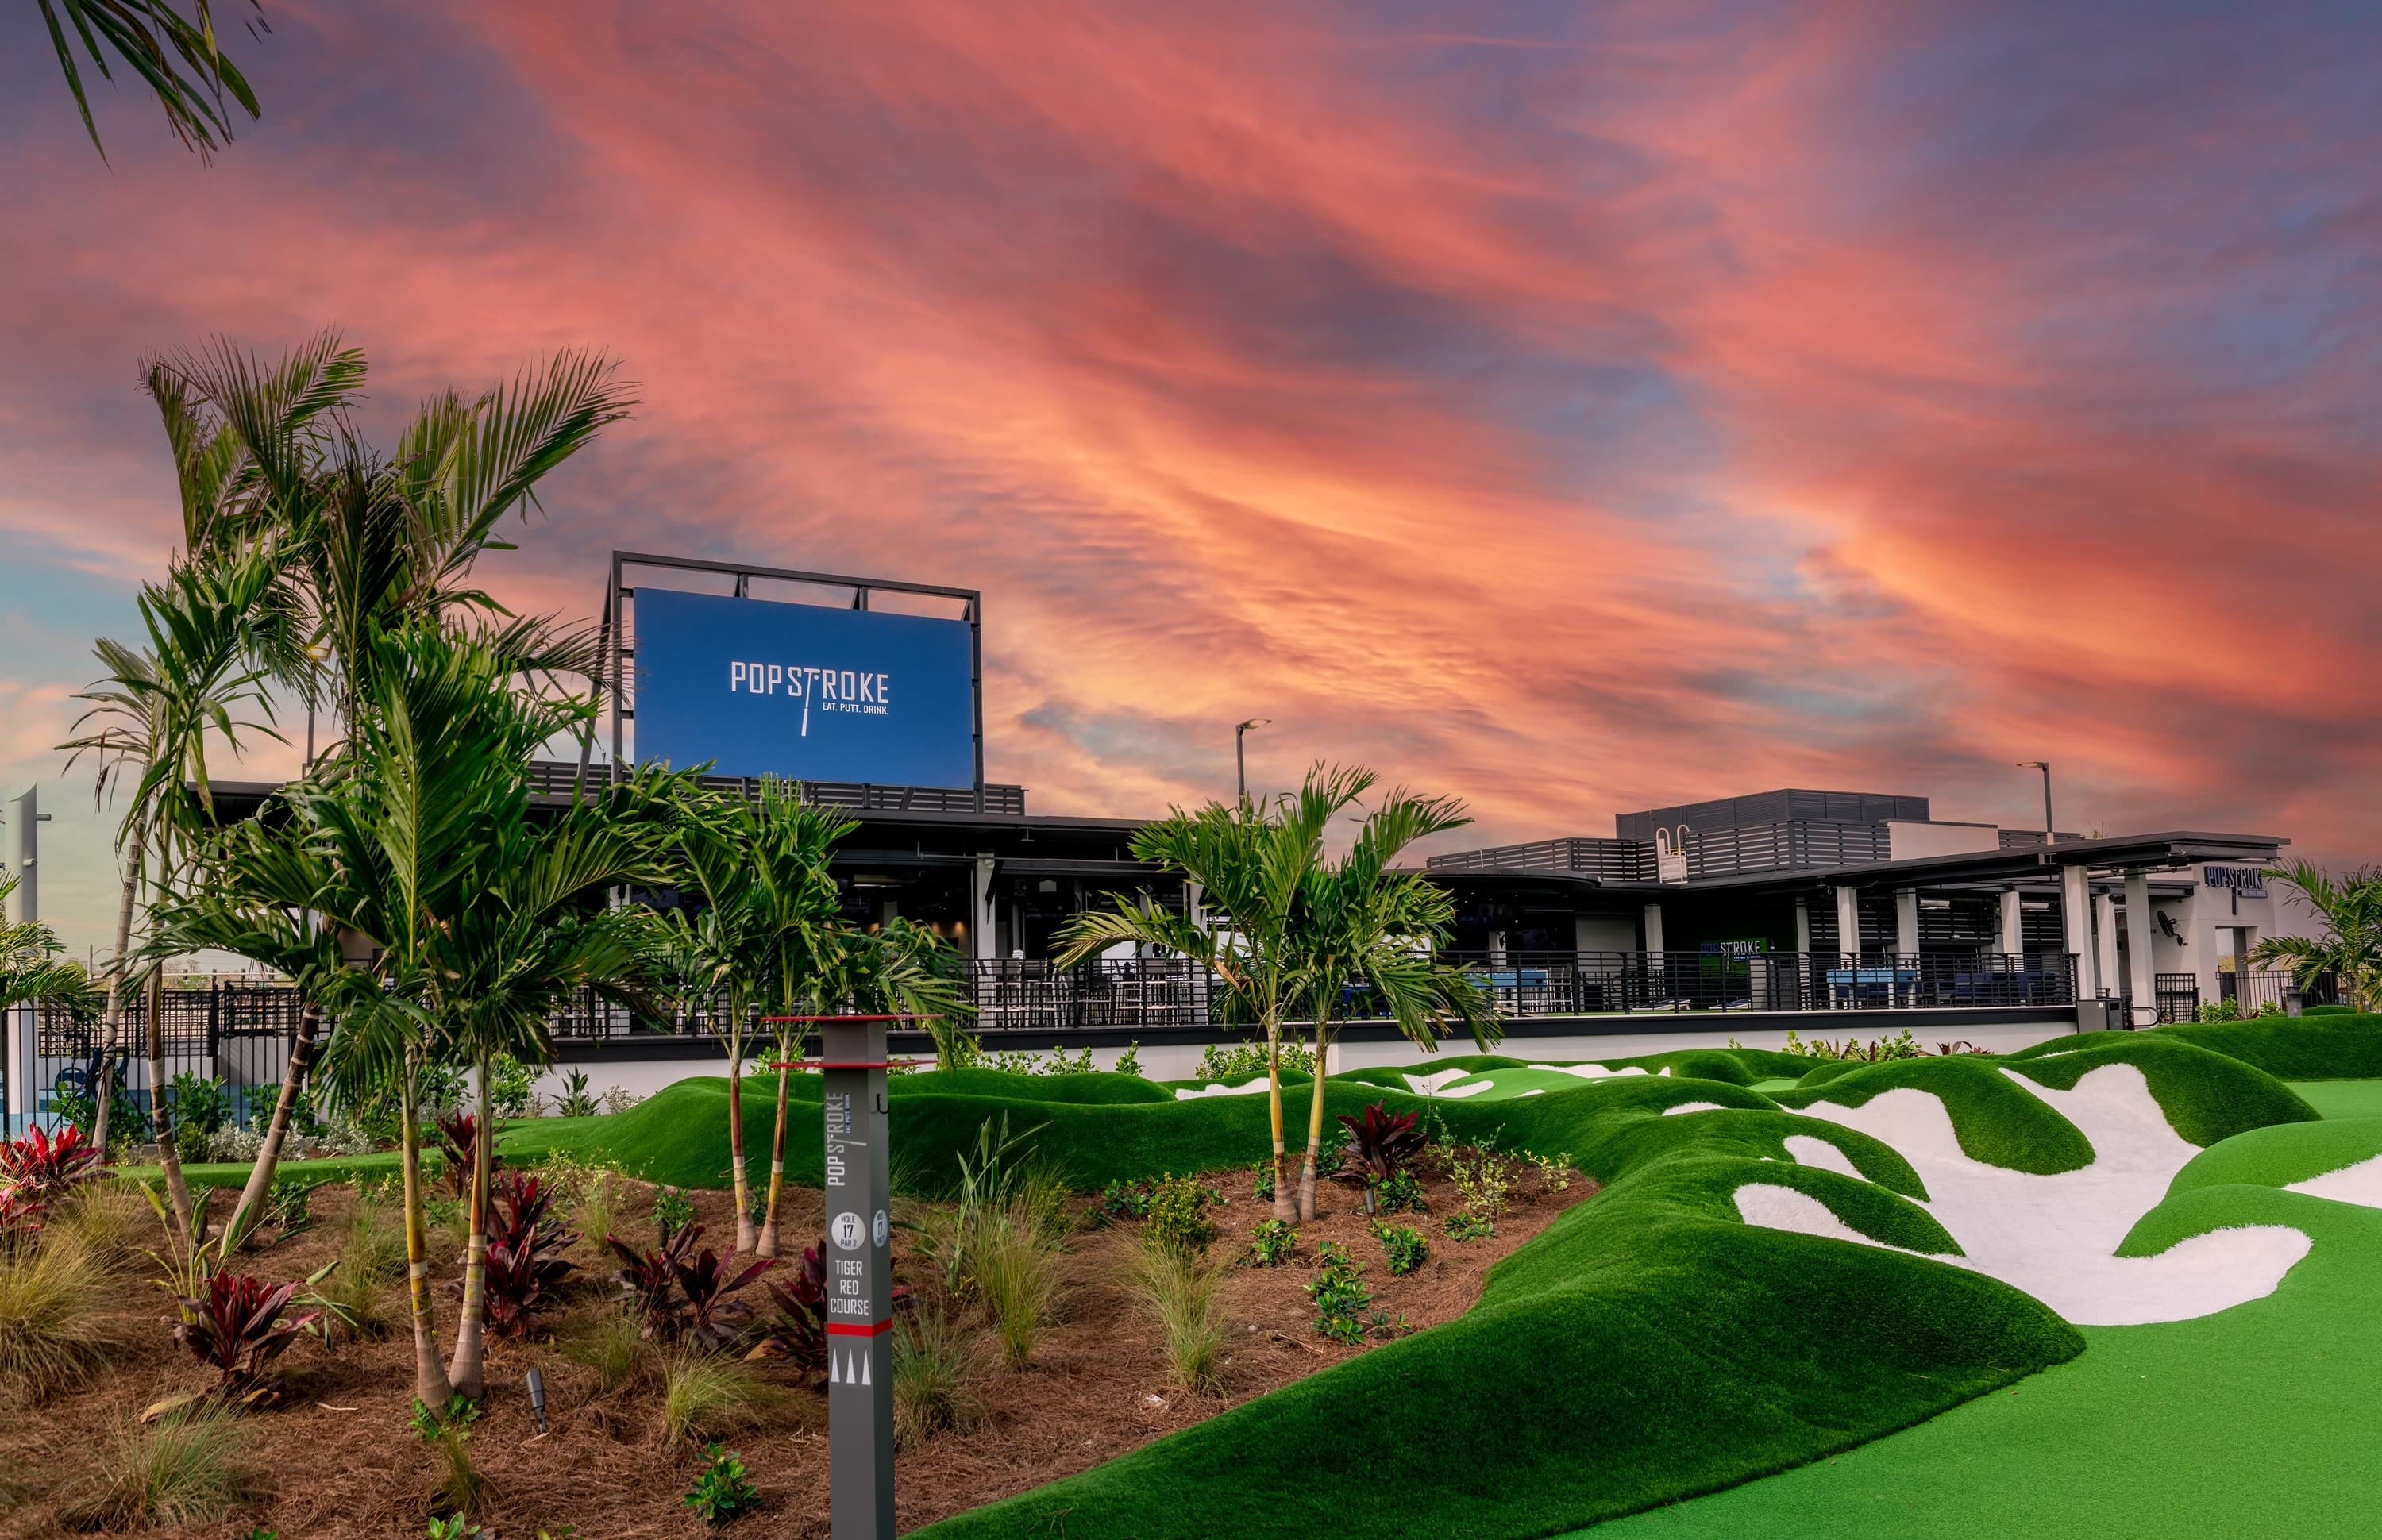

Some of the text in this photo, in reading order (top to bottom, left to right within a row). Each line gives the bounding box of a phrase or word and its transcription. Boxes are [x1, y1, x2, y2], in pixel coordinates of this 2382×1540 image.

[823, 702, 889, 715] EAT. PUTT. DRINK.
[844, 1224, 854, 1238] 17
[834, 1259, 863, 1276] TIGER
[840, 1279, 859, 1296] RED
[831, 1298, 869, 1315] COURSE
